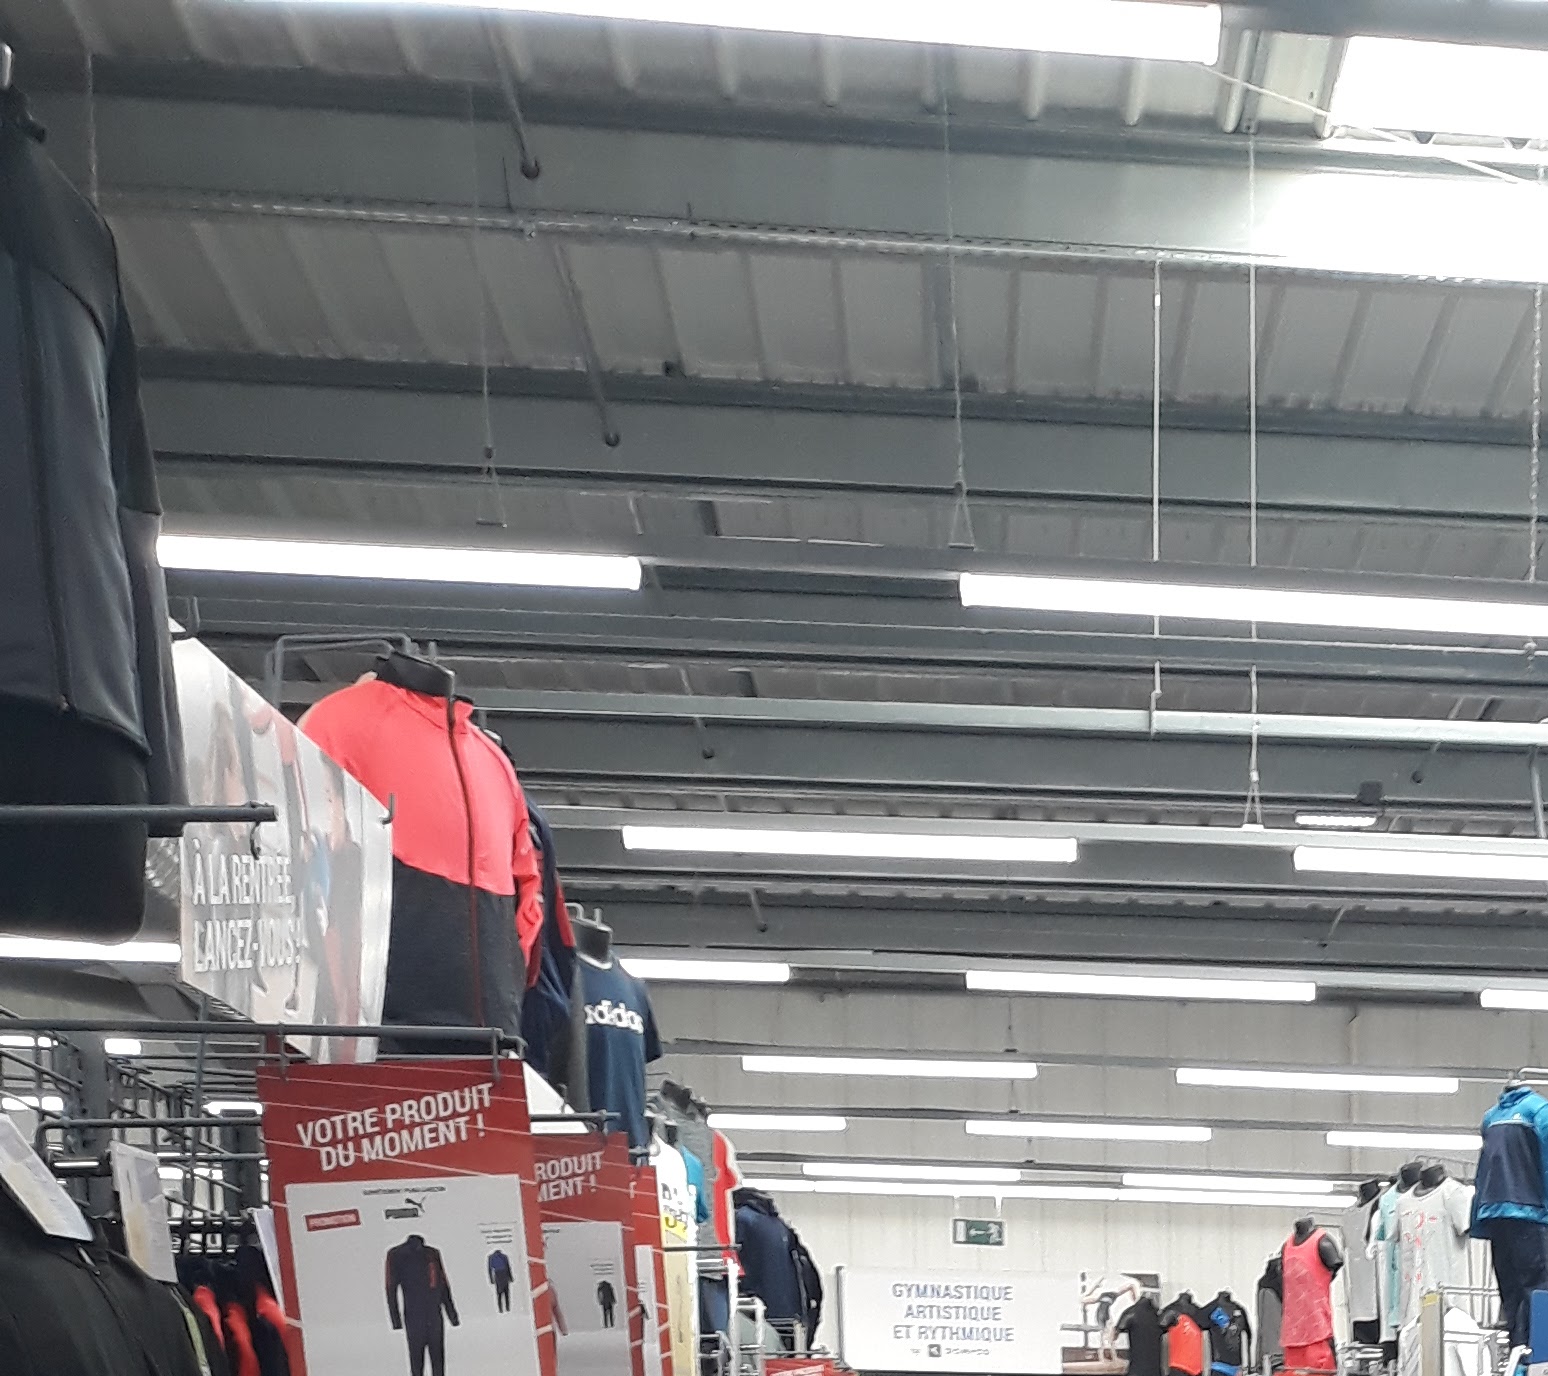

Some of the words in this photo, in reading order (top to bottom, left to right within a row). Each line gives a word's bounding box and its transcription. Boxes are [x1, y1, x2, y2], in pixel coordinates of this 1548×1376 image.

[296, 1107, 381, 1148] VOTRE
[385, 1082, 493, 1130] PRODUIT
[320, 1141, 355, 1172] DU
[361, 1116, 470, 1163] MOMENT
[534, 1151, 605, 1182] RODUIT
[537, 1176, 585, 1202] MENT
[892, 1283, 1014, 1301] GYMNASTIQUE
[904, 1304, 1002, 1321] ARTISTIQUE
[893, 1325, 916, 1340] ET
[918, 1325, 1015, 1342] RYTHMIQUE
